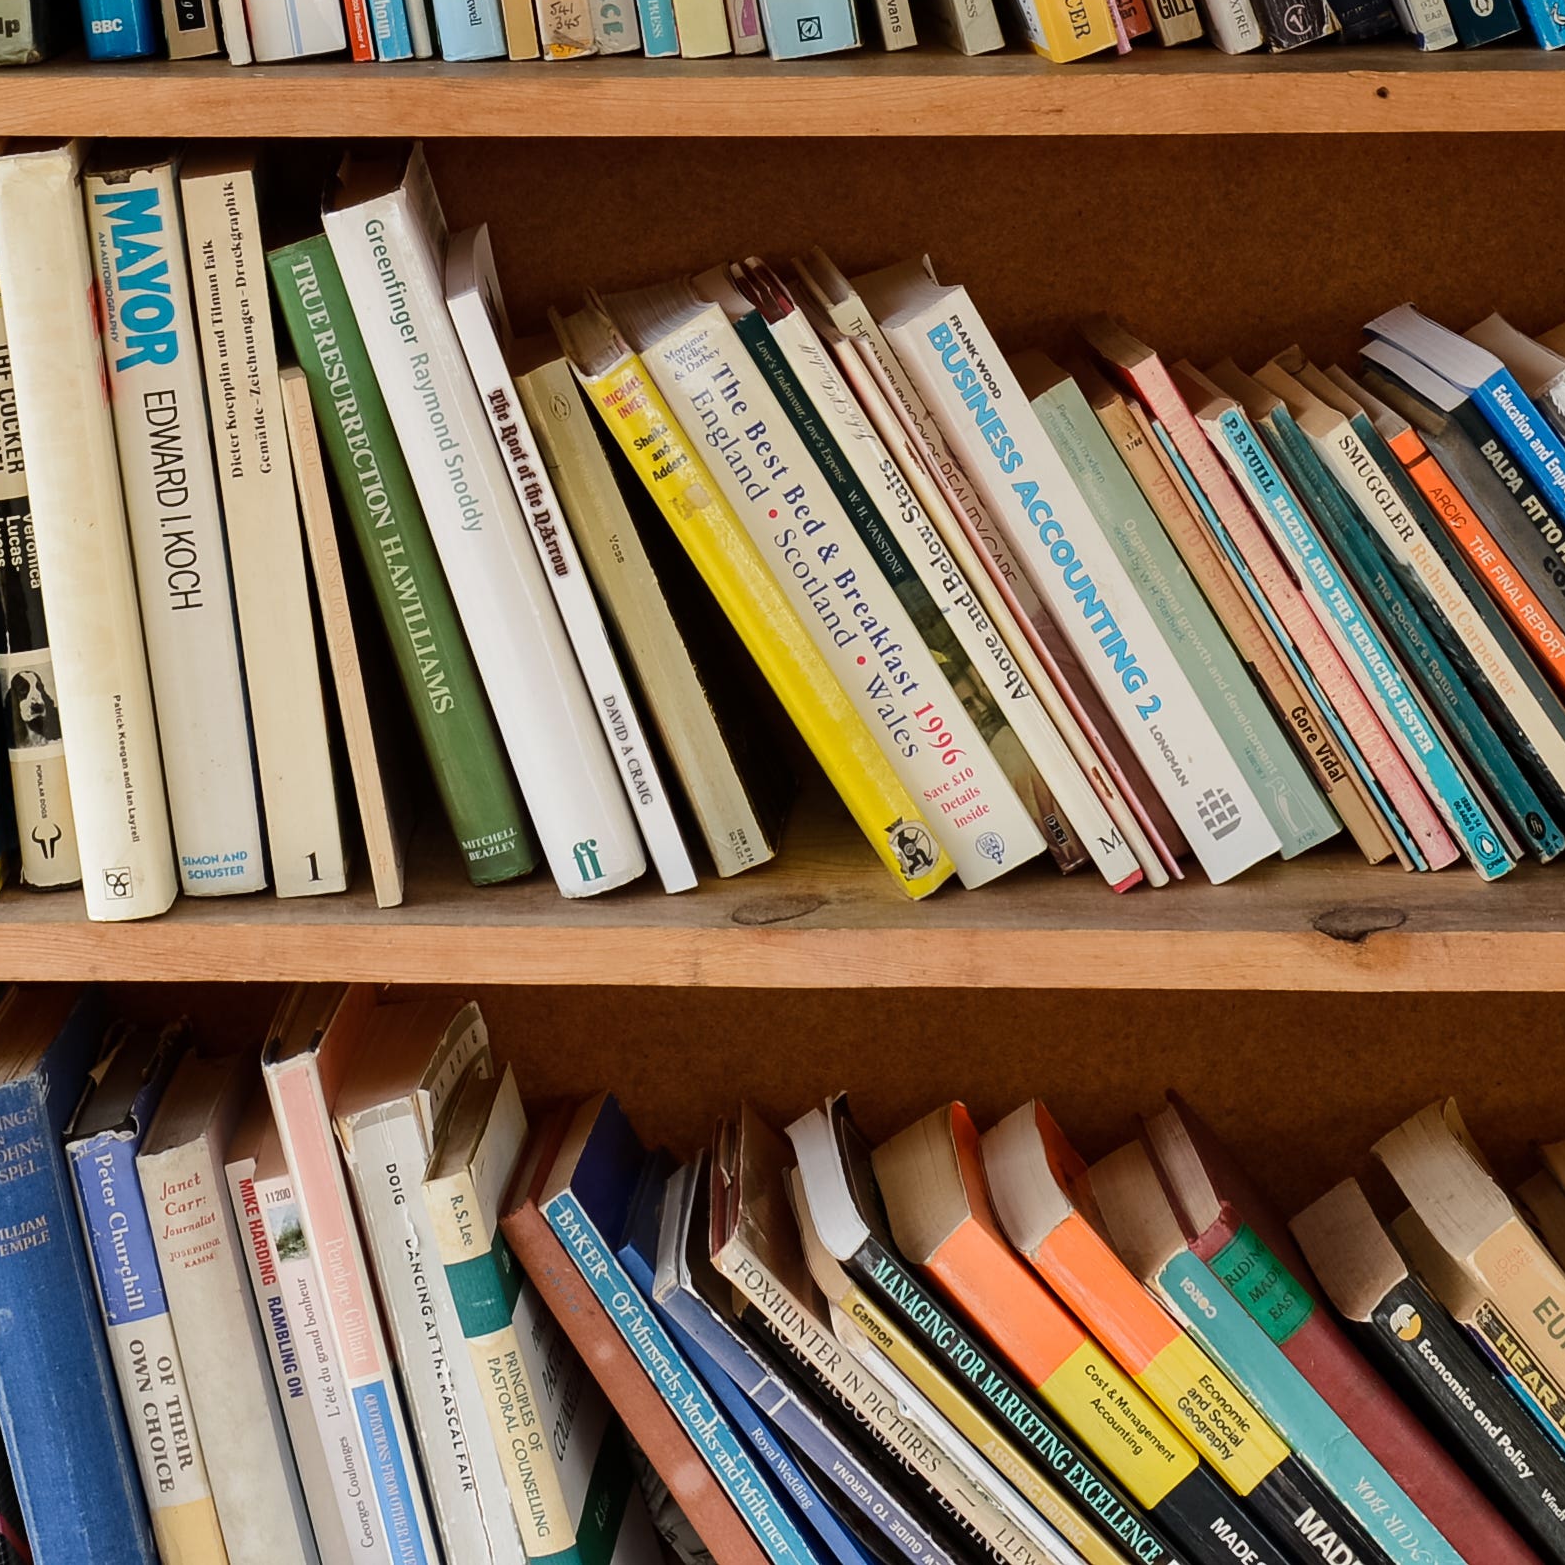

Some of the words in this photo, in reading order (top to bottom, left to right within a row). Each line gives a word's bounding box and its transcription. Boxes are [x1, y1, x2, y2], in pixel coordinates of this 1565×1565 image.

[94, 186, 179, 373] MAYOR
[366, 219, 420, 344] Greenfinger
[143, 388, 187, 507] EDWARD
[161, 513, 189, 532] I.
[926, 320, 1023, 475] BUSINESS
[1011, 478, 1154, 695] ACCOUNTING
[1135, 696, 1163, 723] 2
[1337, 435, 1416, 543] SMUGGLER
[1480, 440, 1524, 495] BALPA
[1521, 495, 1547, 525] FIT
[1537, 514, 1561, 544] TO
[163, 536, 204, 614] KOCH
[1147, 724, 1189, 789] LONGMAN
[1289, 705, 1320, 747] Gore
[1309, 737, 1347, 785] Vidal
[462, 827, 517, 849] MITCHELL
[468, 840, 516, 861] BEAZLEY
[95, 1154, 117, 1208] Peter
[108, 1210, 146, 1312] Churchill
[451, 1194, 464, 1210] R.
[456, 1210, 469, 1223] S.
[459, 1224, 473, 1246] Lee
[733, 1259, 844, 1374] FOXHUNTER
[843, 1368, 866, 1396] IN
[863, 1393, 943, 1474] PICTURES
[1083, 1363, 1111, 1393] Cost
[1105, 1387, 1118, 1401] &
[129, 1338, 153, 1394] OWN
[142, 1401, 176, 1494] CHOICE
[1090, 1397, 1144, 1457] Accounting
[1109, 1392, 1177, 1464] Management
